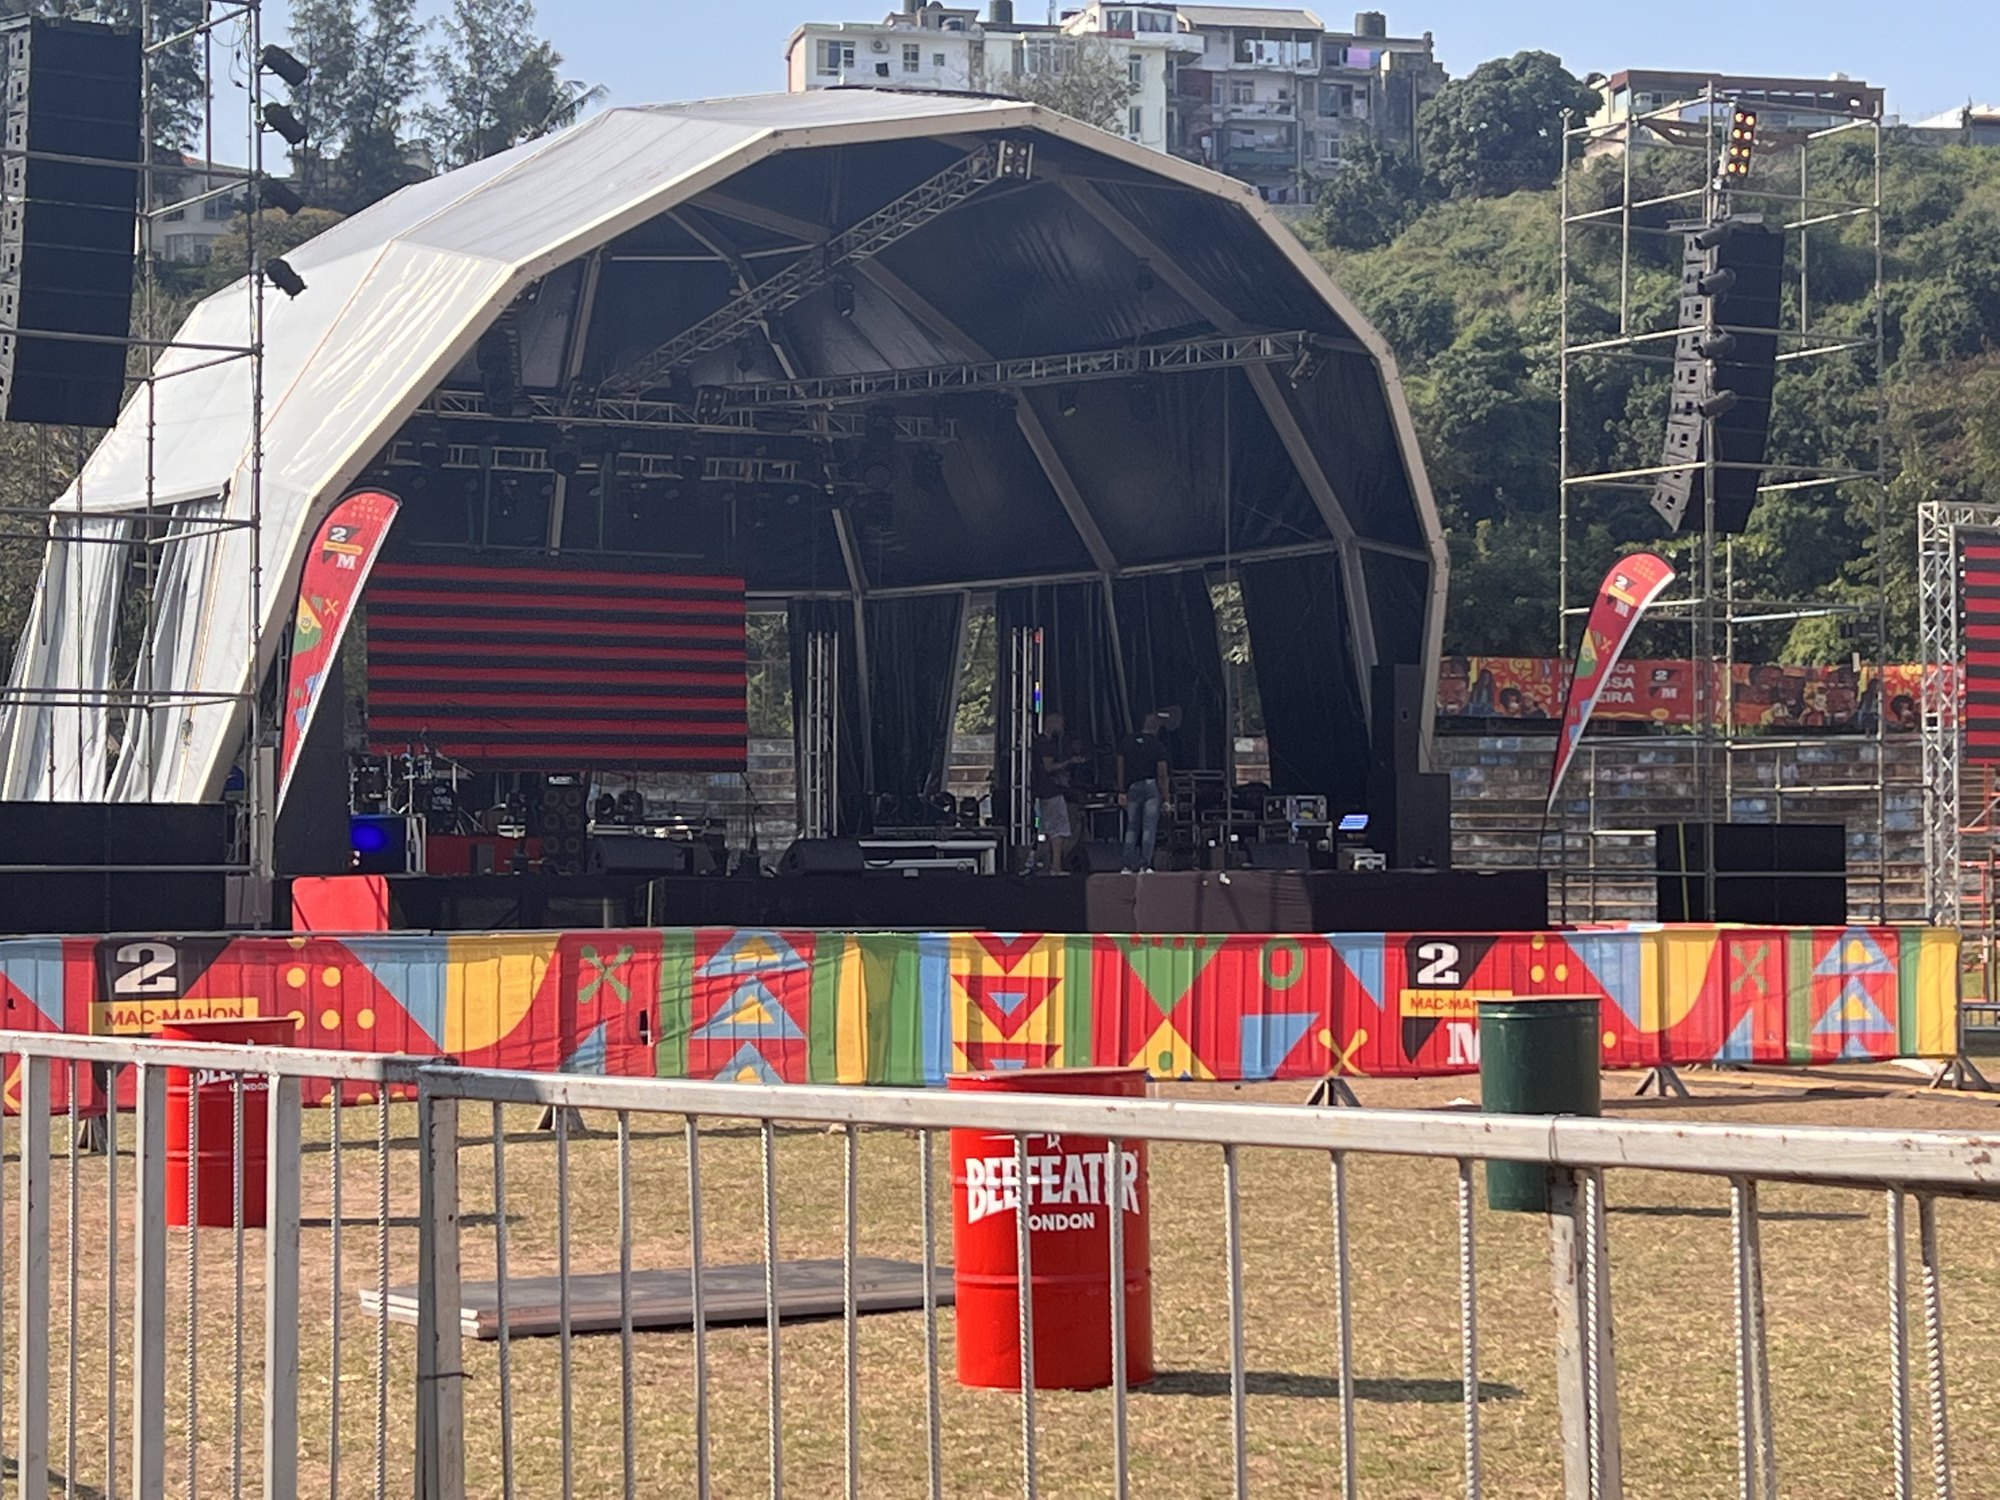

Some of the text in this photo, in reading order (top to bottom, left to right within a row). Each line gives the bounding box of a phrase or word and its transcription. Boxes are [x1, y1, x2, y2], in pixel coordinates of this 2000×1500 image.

[330, 527, 347, 542] 2
[336, 553, 357, 571] M
[1615, 575, 1628, 591] 2
[1655, 670, 1668, 681] 2
[1661, 688, 1678, 699] M
[114, 942, 177, 994] 2
[1417, 942, 1460, 985] 2
[1028, 1212, 1095, 1231] ONDON
